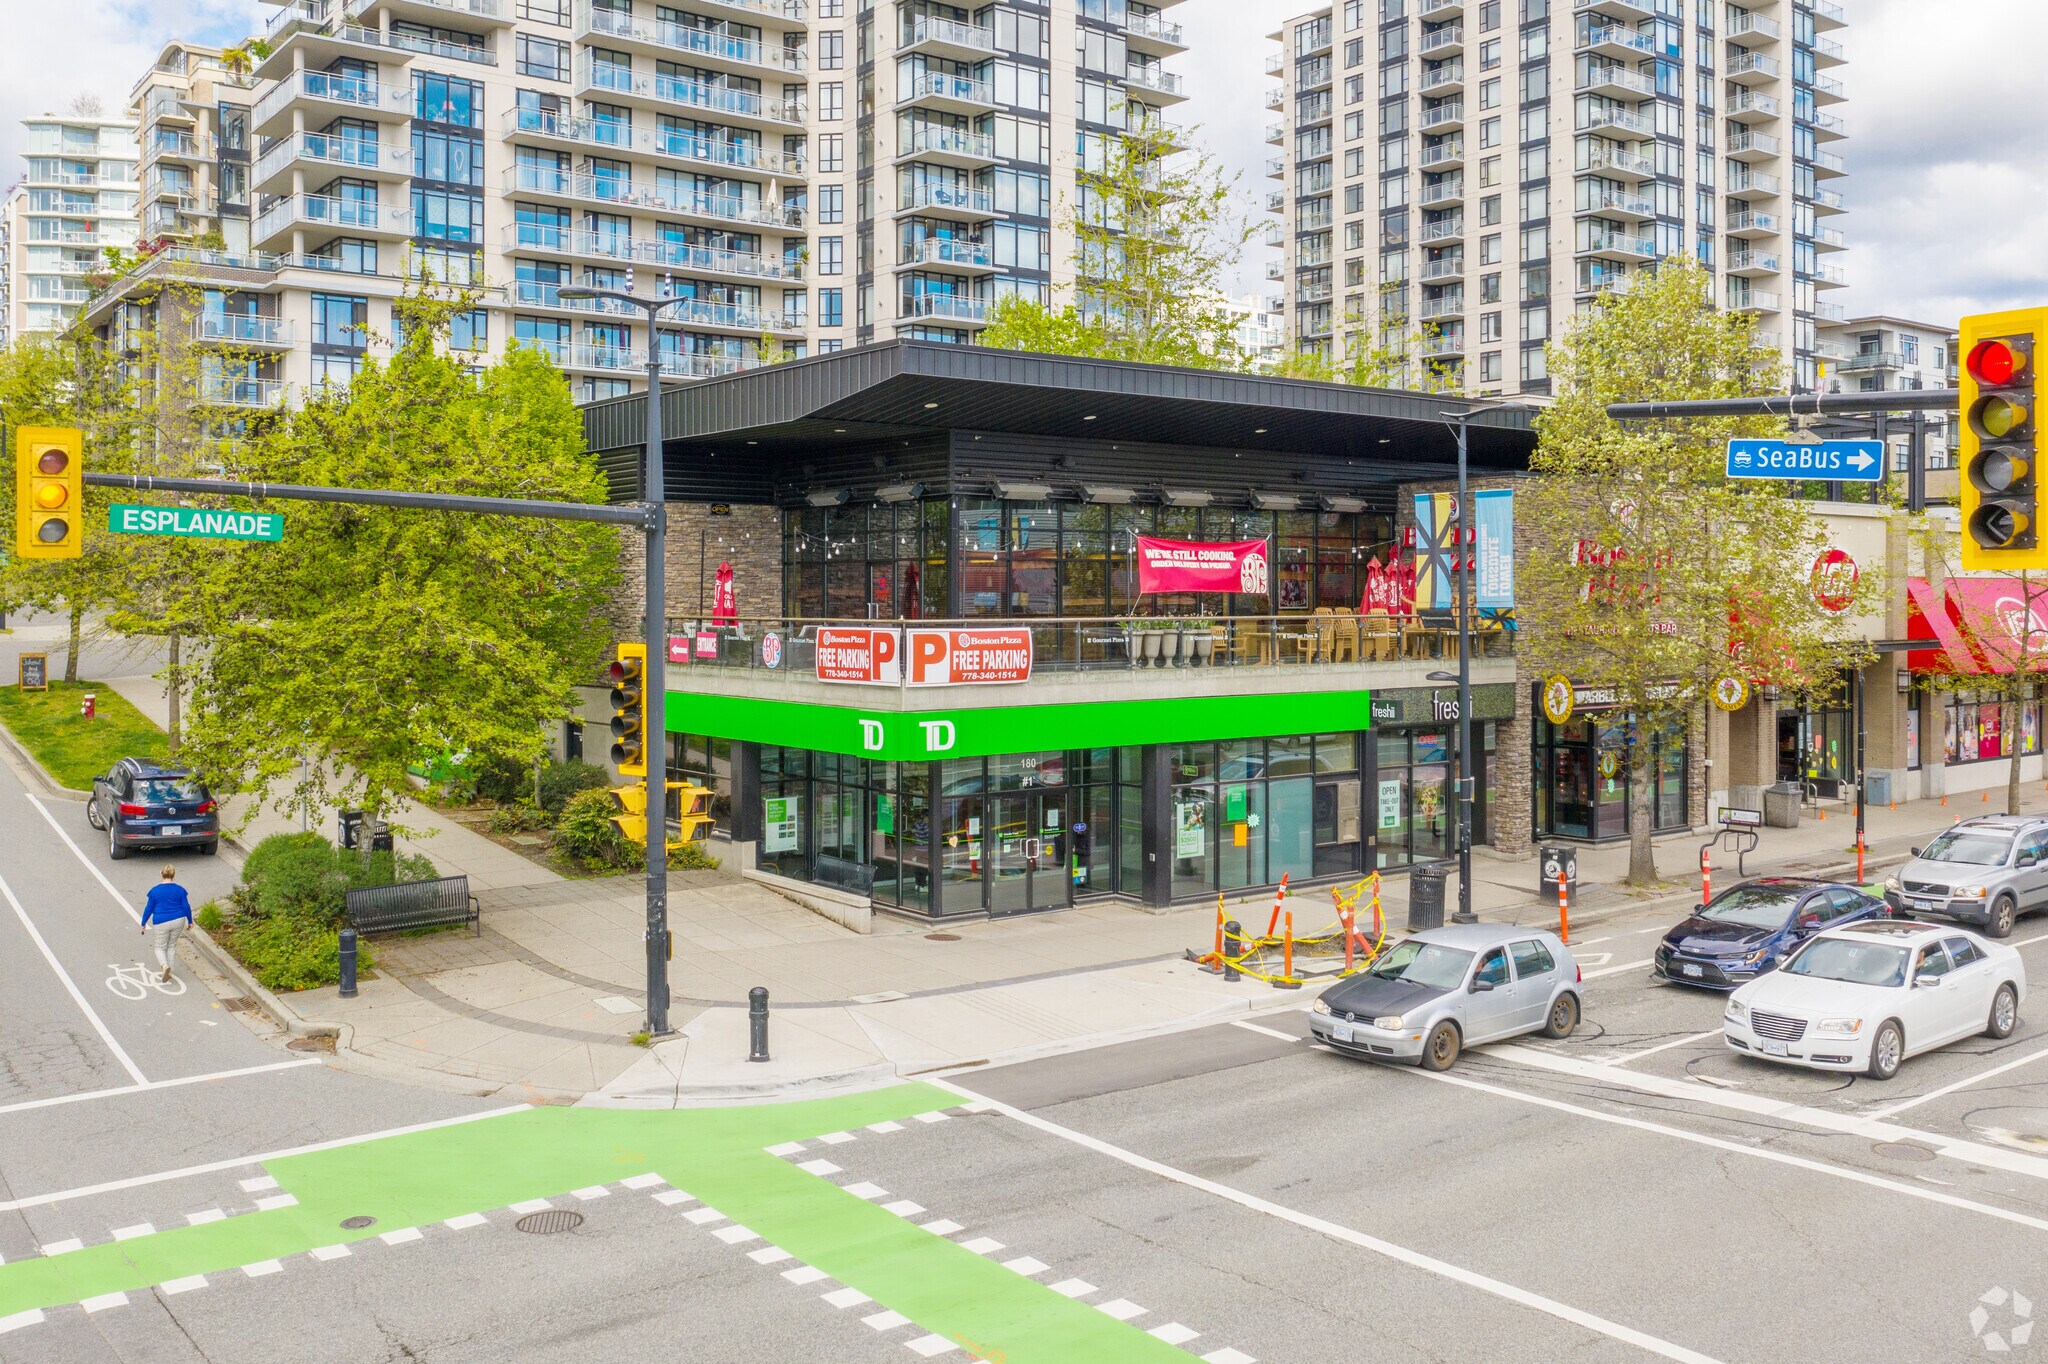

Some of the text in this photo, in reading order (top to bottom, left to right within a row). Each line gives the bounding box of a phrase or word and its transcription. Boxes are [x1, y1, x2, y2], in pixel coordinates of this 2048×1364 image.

[1757, 447, 1841, 469] SeaBus
[712, 504, 730, 514] OPEN
[123, 509, 272, 536] ESPLANADE
[1144, 549, 1237, 560] WE'RE STILL COOKING.
[697, 637, 717, 653] ENTRANCE
[831, 635, 851, 644] Boston
[850, 635, 866, 644] Pizza
[971, 637, 1000, 645] Boston
[1000, 636, 1022, 644] Pizza
[818, 647, 870, 670] FREE PARKING
[872, 631, 896, 681] P
[912, 633, 948, 683] P
[952, 649, 1028, 671] FREE PARKING
[825, 669, 864, 679] 778-340-1514
[962, 671, 1018, 680] 778-340-1514
[1372, 703, 1396, 719] freshii
[1433, 690, 1473, 721] fresi
[858, 719, 884, 751] TD
[919, 720, 956, 751] TD
[1418, 734, 1438, 745] OPEN
[1020, 758, 1036, 769] 180
[1022, 776, 1033, 787] #1
[1382, 786, 1397, 796] OPEN
